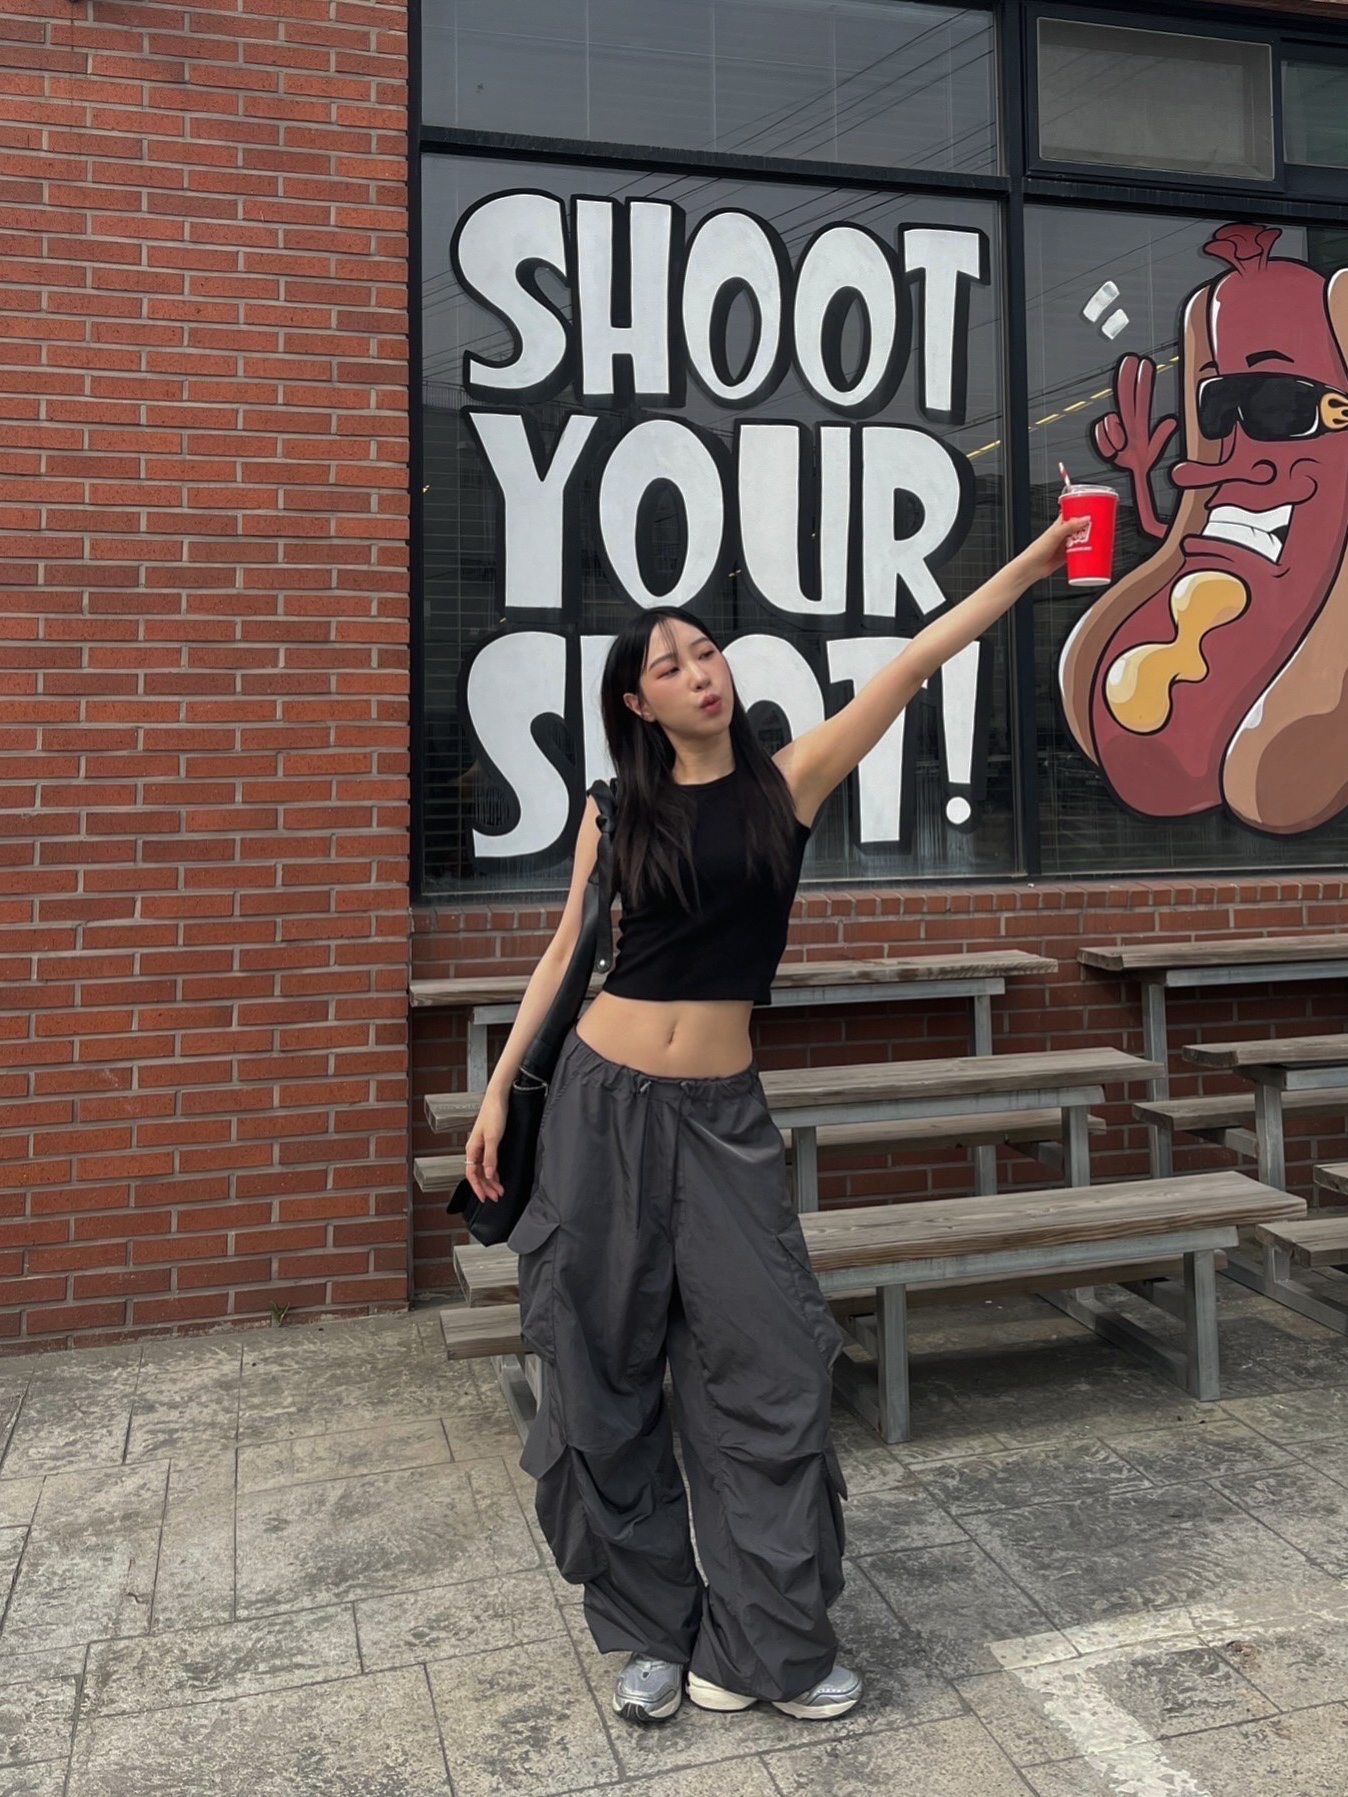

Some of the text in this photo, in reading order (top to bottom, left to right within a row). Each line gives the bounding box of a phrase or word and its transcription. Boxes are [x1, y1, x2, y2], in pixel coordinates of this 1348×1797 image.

[457, 193, 980, 411] SHOOT
[469, 412, 960, 618] YOUR
[466, 631, 980, 858] ST!
